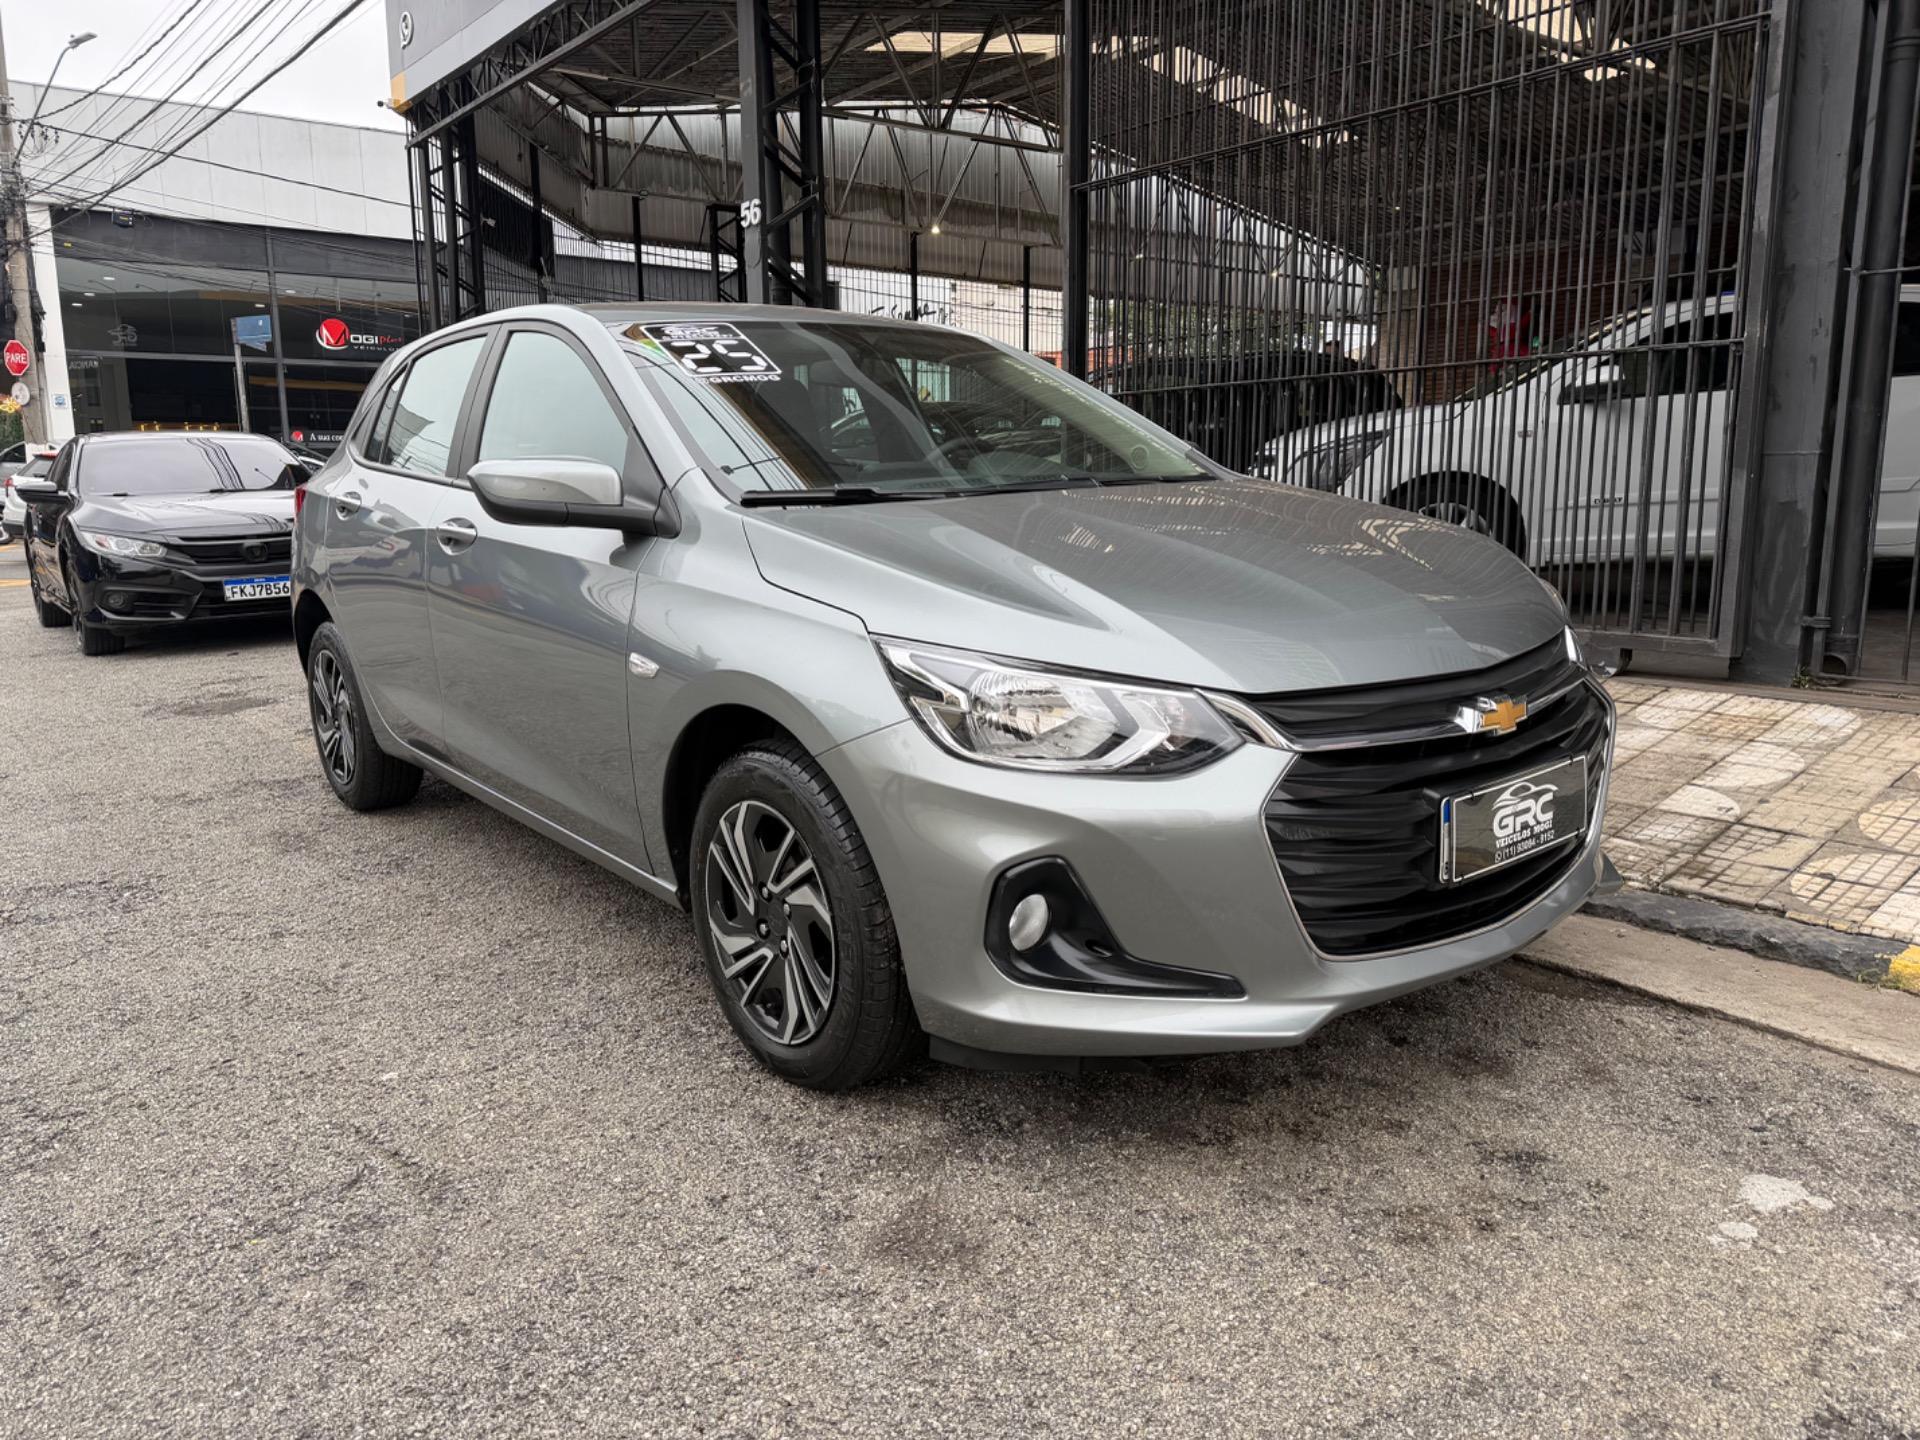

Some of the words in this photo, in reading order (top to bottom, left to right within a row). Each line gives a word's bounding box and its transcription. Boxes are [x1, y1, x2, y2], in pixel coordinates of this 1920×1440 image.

[740, 198, 762, 228] 56
[6, 352, 27, 364] PARE
[671, 340, 767, 372] 25
[310, 432, 317, 441] A
[230, 582, 290, 598] FKJ7B56
[1493, 791, 1554, 838] GRC
